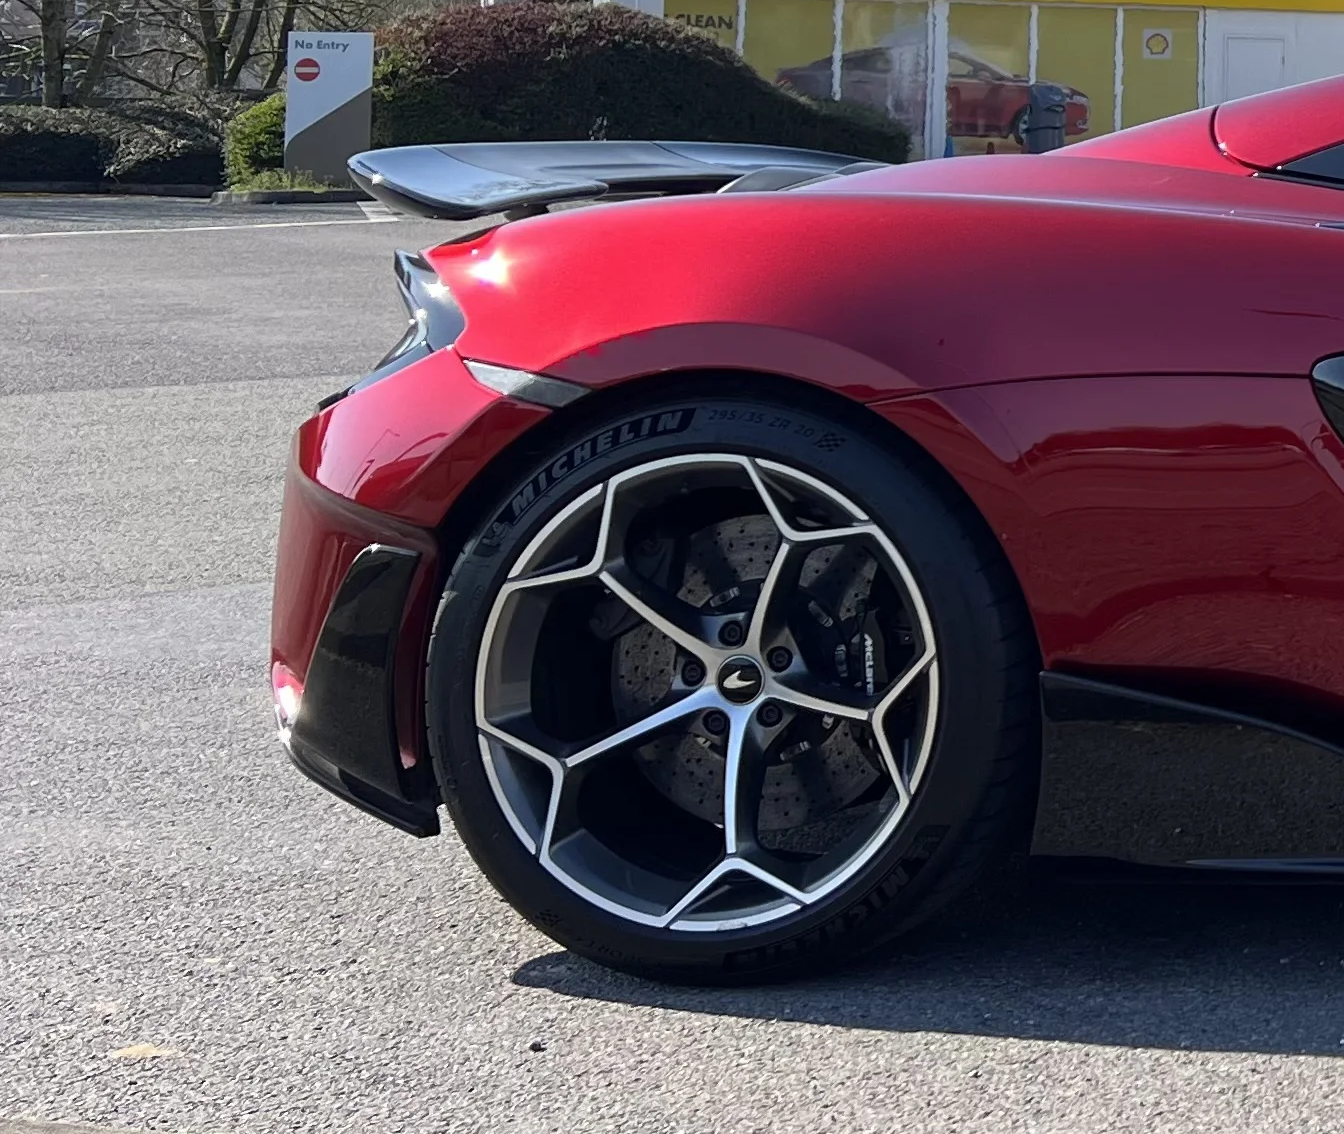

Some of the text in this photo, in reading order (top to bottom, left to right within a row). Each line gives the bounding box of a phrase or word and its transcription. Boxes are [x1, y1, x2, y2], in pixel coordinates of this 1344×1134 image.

[294, 39, 350, 53] No Entry
[767, 414, 791, 430] ZR
[793, 423, 815, 439] 20
[511, 410, 685, 517] MICHELIN
